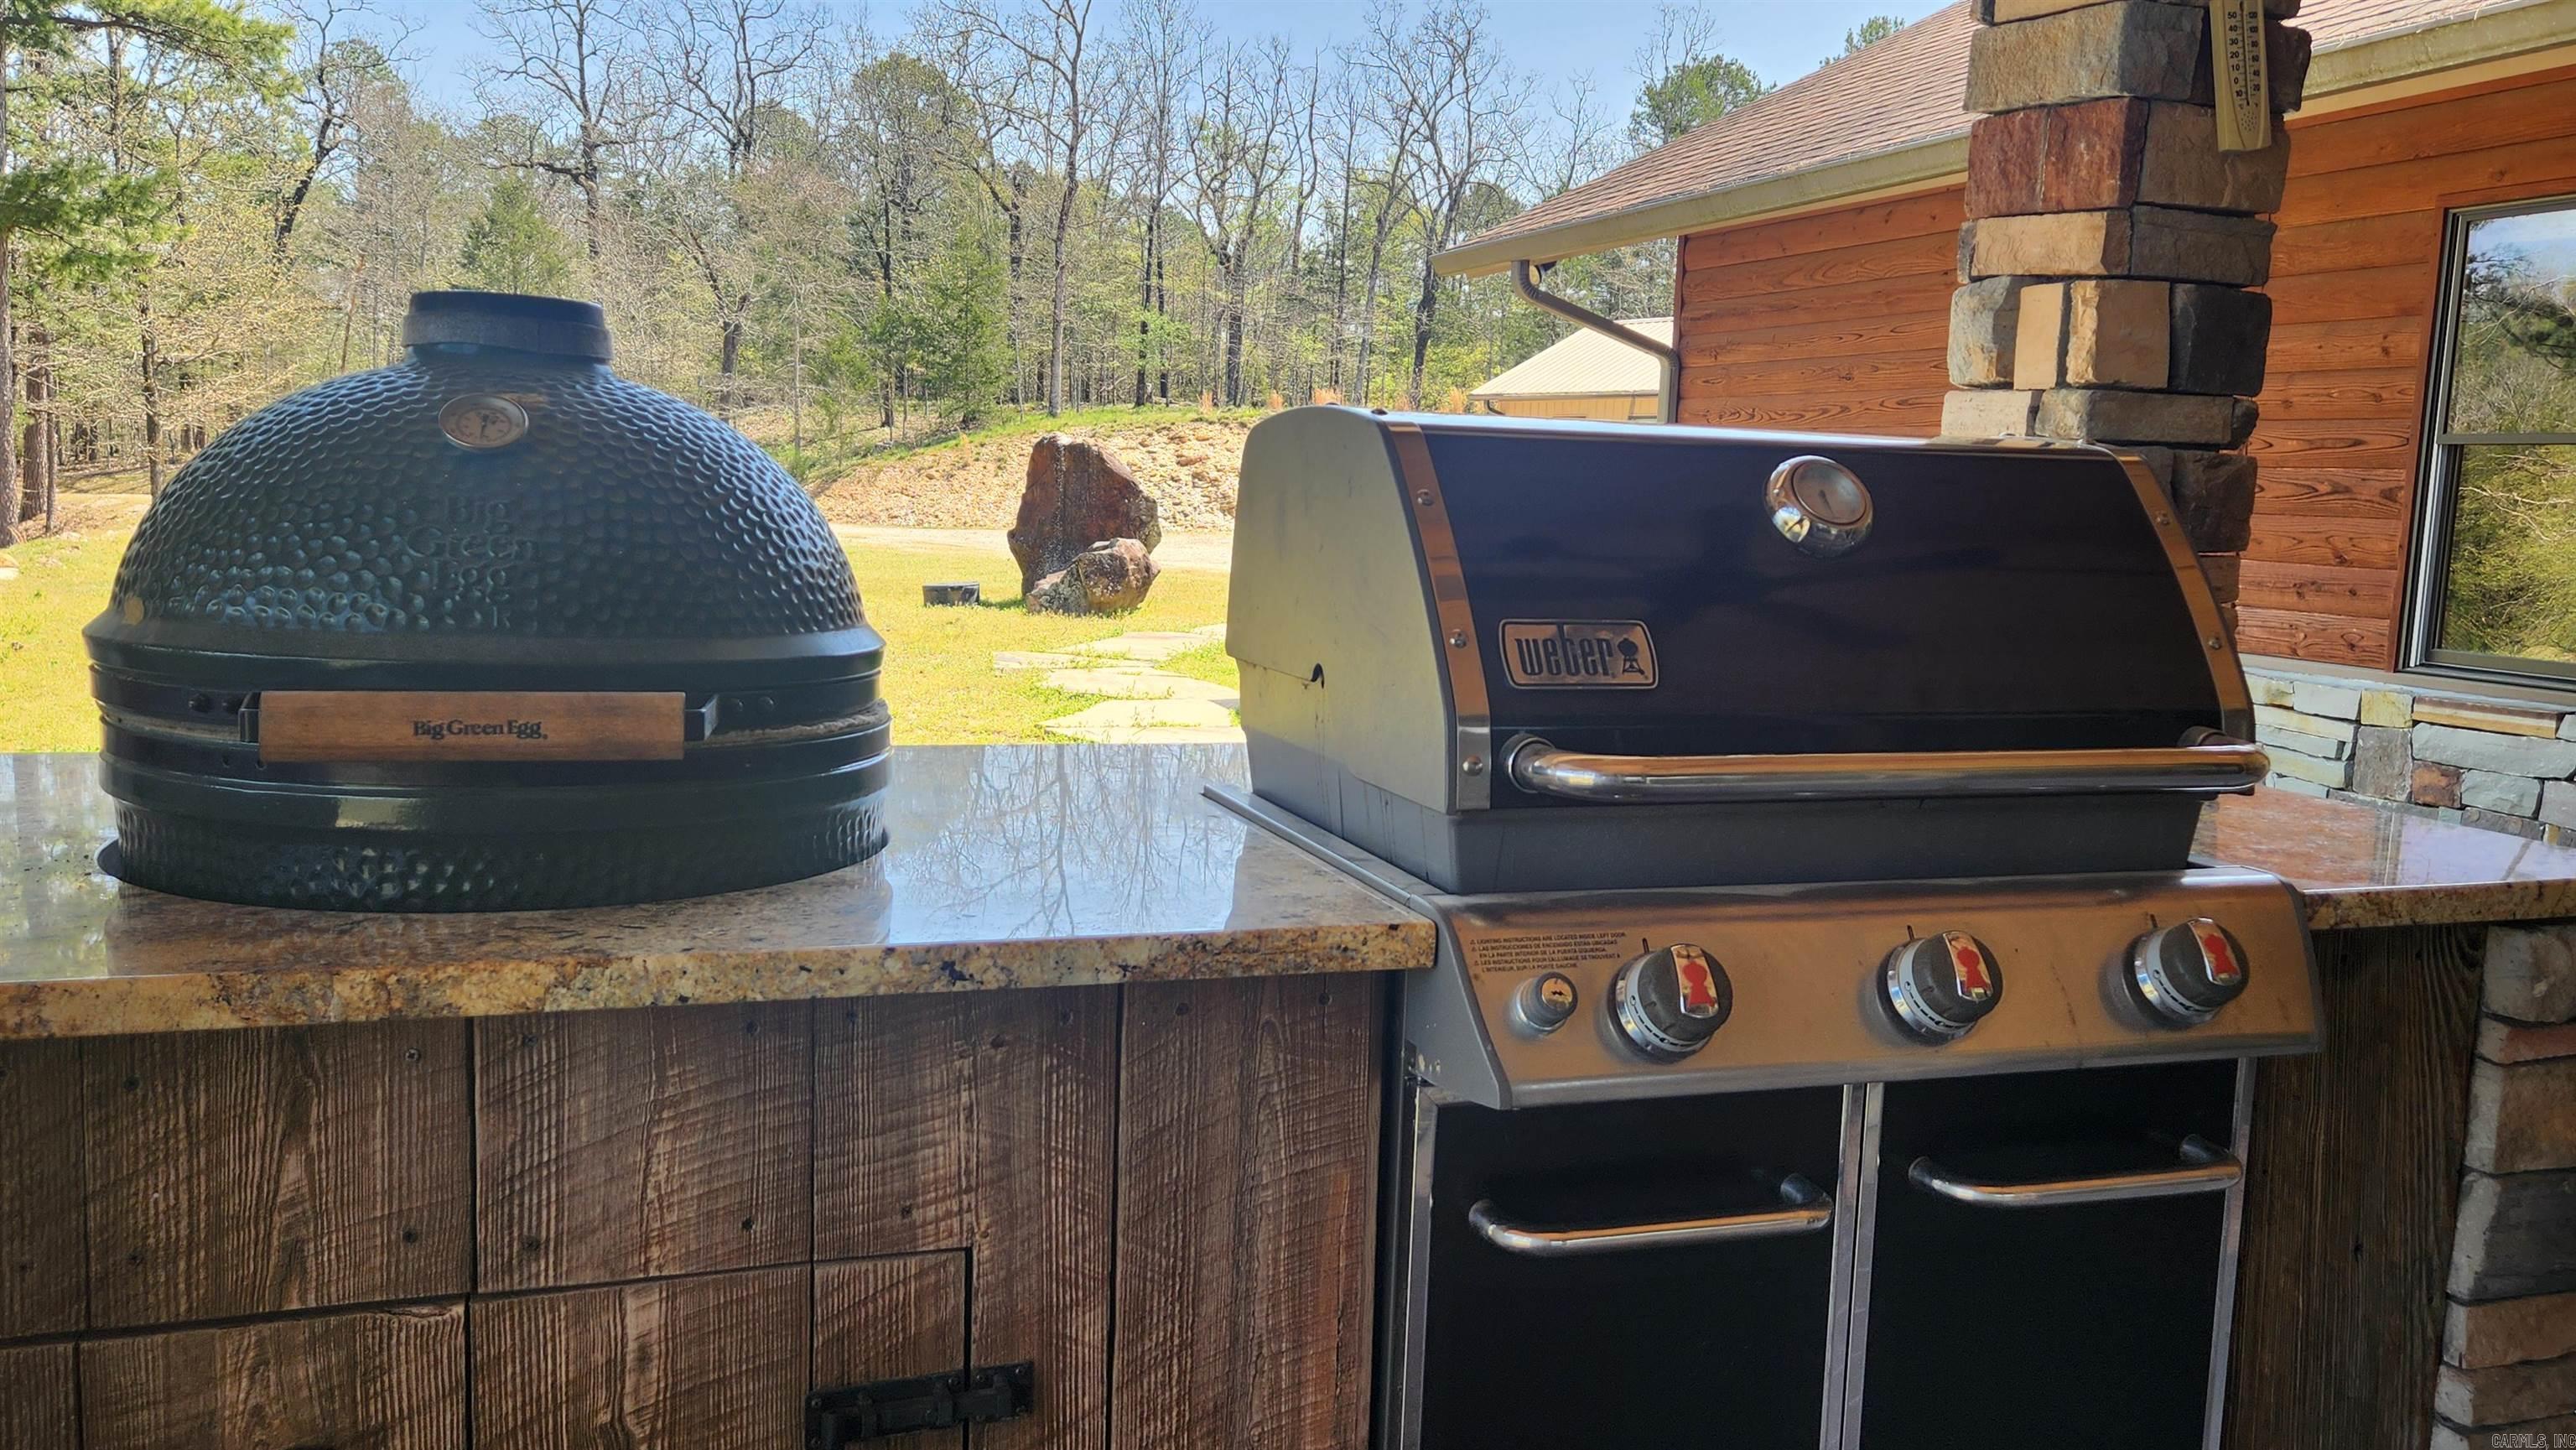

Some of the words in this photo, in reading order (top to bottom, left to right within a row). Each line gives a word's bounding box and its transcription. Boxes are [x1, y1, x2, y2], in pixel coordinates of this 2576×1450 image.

[2227, 11, 2237, 19] 50
[2228, 24, 2238, 33] 40
[2229, 37, 2239, 46] 30
[2230, 50, 2240, 59] 20
[2231, 63, 2241, 71] 10
[2233, 76, 2239, 85] 0
[1514, 624, 1613, 677] weber
[413, 720, 444, 740] Big
[446, 720, 504, 735] Green
